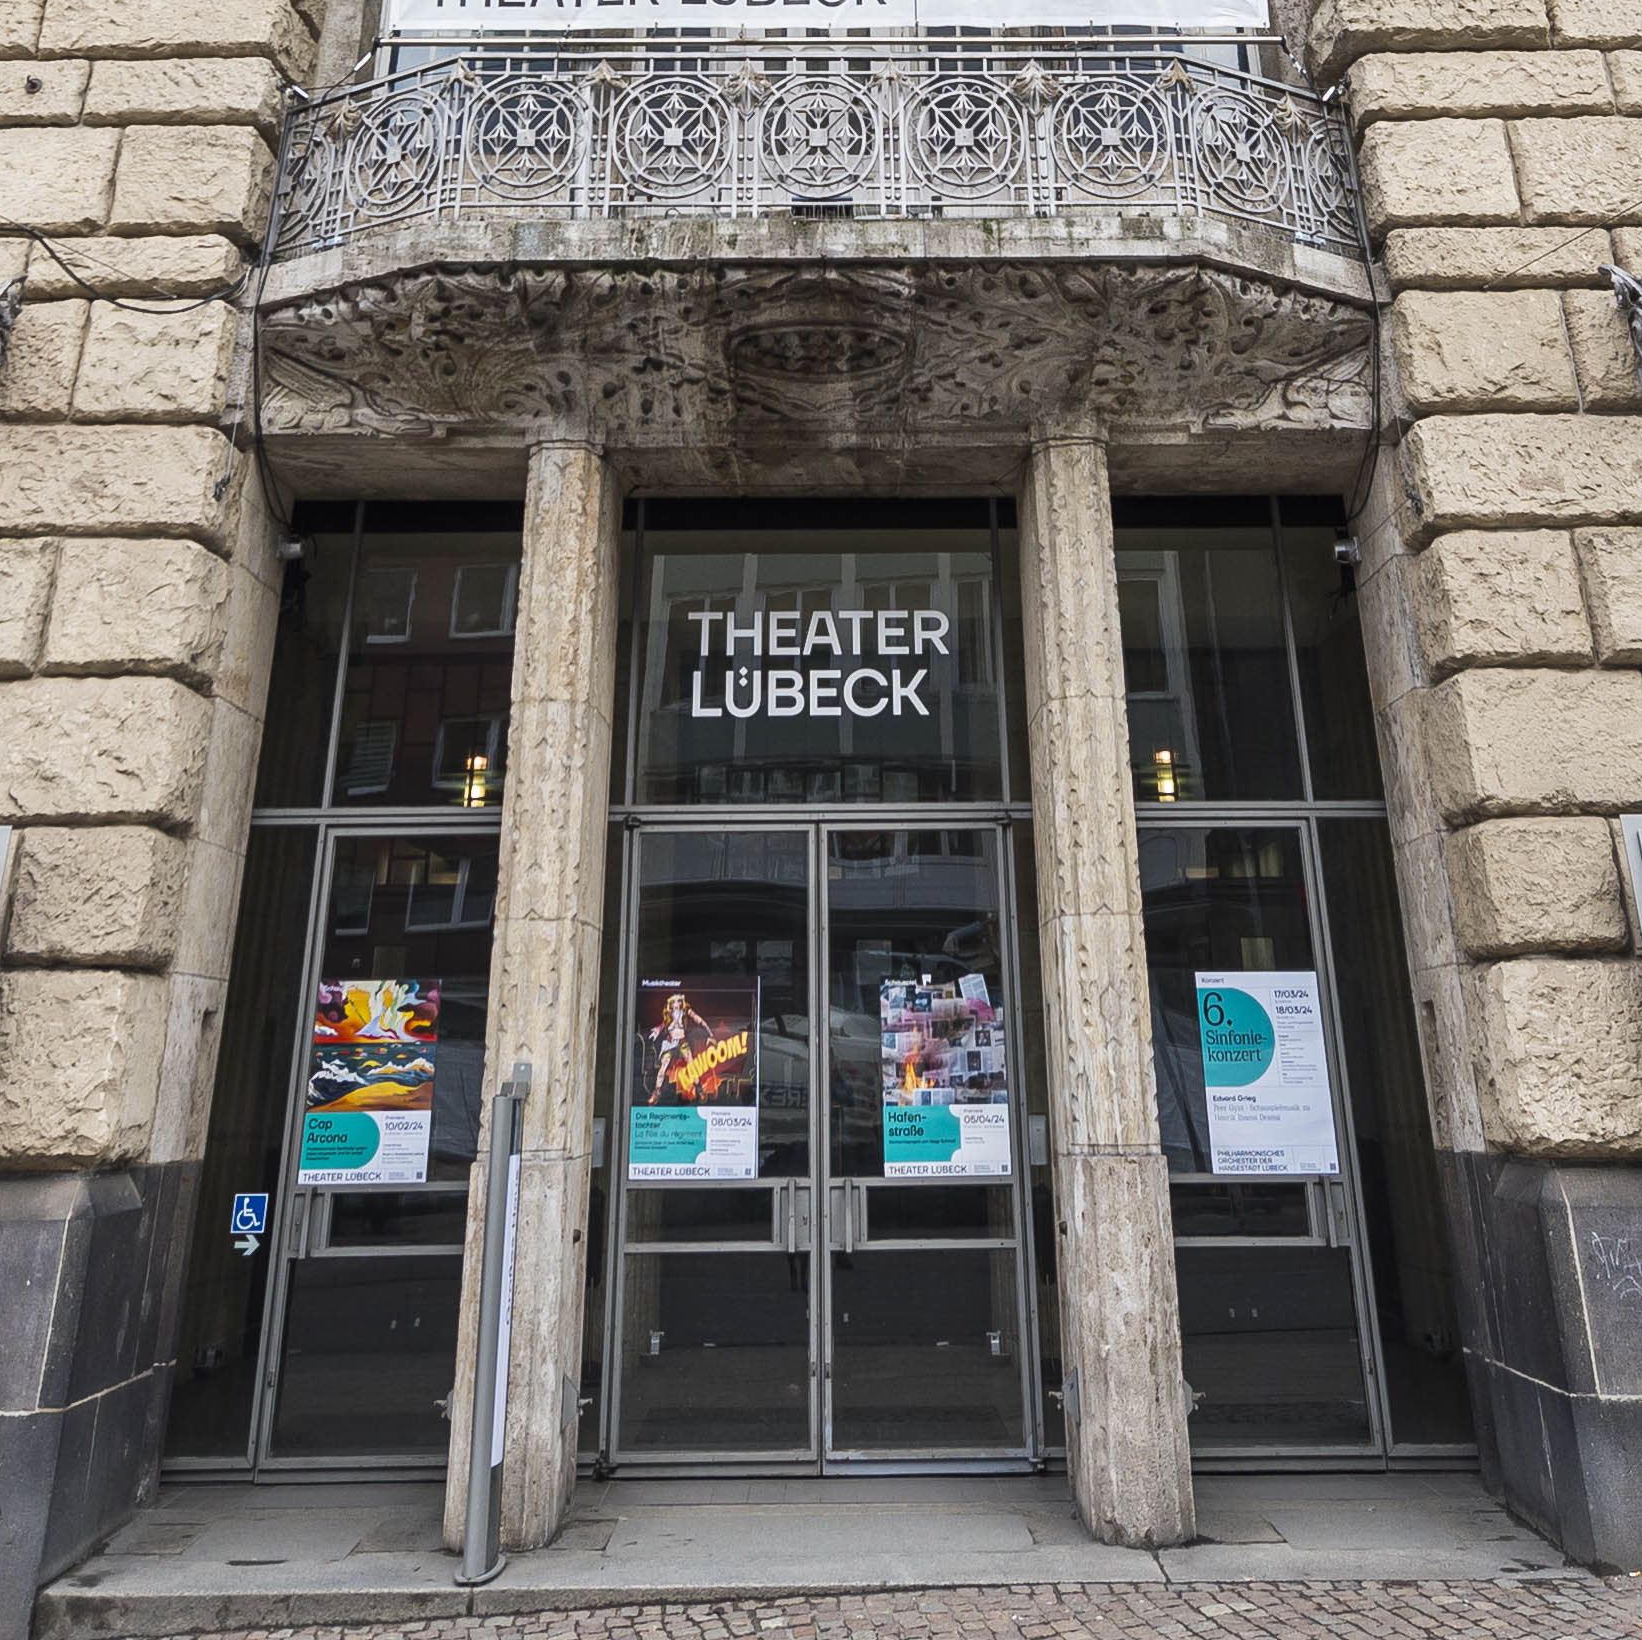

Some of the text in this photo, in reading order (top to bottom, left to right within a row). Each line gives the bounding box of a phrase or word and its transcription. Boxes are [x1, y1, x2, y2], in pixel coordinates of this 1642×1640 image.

[687, 609, 951, 656] THEATER
[691, 666, 930, 719] LÜBECK
[1274, 990, 1309, 999] 17/03/24
[1203, 992, 1232, 1027] 6.
[1275, 1006, 1313, 1015] 18/03/24
[1205, 1029, 1268, 1046] Sinfonie-
[1207, 1047, 1262, 1063] konzert
[678, 1031, 749, 1092] KAWOOM!
[711, 1118, 752, 1127] 08/03/24
[888, 1112, 926, 1123] Hafen-
[964, 1115, 1005, 1124] 05/04/24
[309, 1118, 333, 1131] Cap
[385, 1121, 423, 1131] 10/02/24
[888, 1125, 924, 1137] straße
[306, 1132, 348, 1144] Arcona
[632, 1167, 672, 1176] THEATER
[889, 1166, 929, 1175] THEATER
[303, 1172, 343, 1183] THEATER
